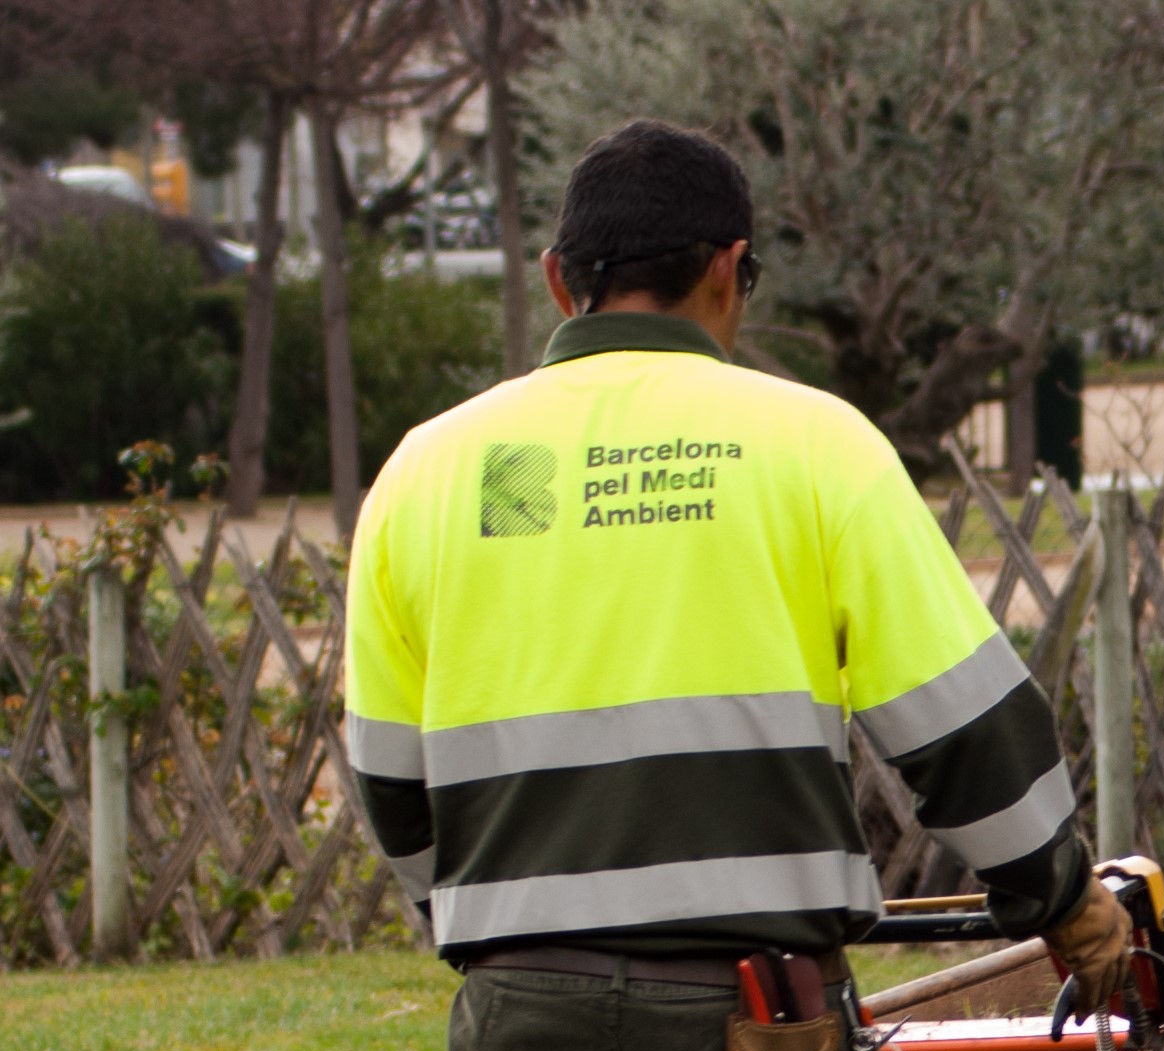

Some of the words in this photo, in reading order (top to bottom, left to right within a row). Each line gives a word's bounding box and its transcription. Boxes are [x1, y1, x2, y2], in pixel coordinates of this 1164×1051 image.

[587, 438, 742, 468] Barcelona
[584, 473, 629, 503] pel
[641, 467, 715, 494] Medi
[583, 499, 715, 529] Ambient
